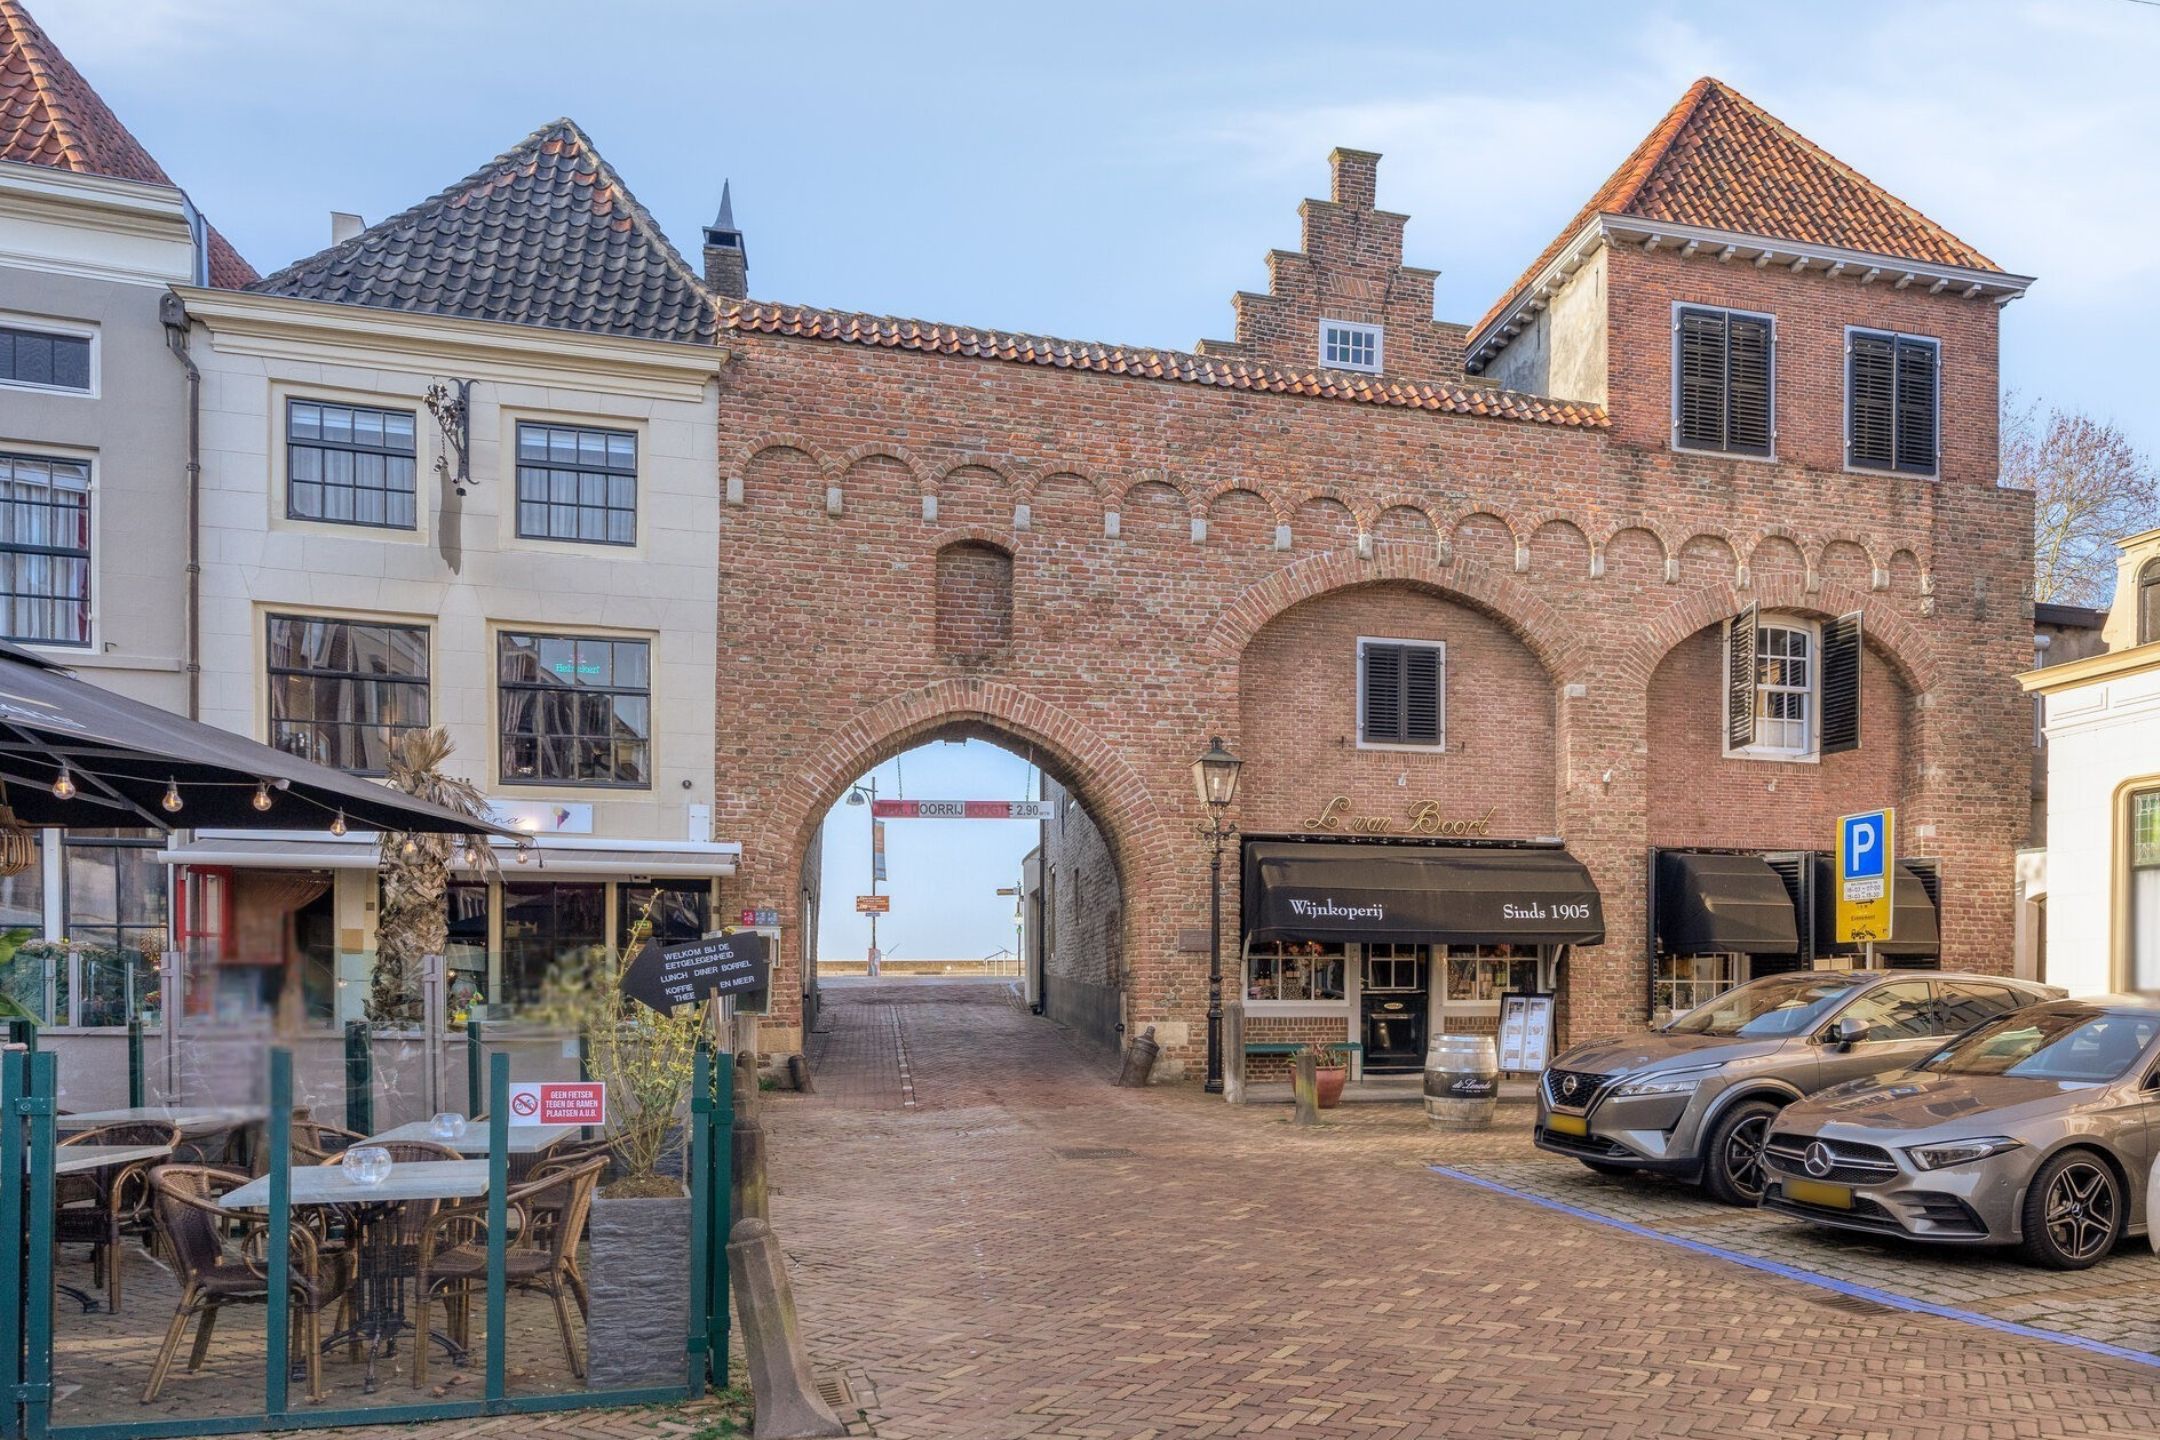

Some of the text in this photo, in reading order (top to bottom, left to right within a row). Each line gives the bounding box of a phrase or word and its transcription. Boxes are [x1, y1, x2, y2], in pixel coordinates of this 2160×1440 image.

[1352, 816, 1393, 833] van
[1392, 799, 1498, 836] Boort
[1852, 822, 1876, 872] P
[1288, 898, 1384, 921] Wijnkoperij
[1503, 902, 1590, 920] Sinds 1905
[664, 943, 730, 961] WELKOM BIJ DE
[665, 951, 734, 970] EETGELEGENHEID
[660, 960, 752, 983] LUNCH DINER BORREL
[665, 975, 755, 995] KOFFIE EN MEER
[674, 991, 696, 1002] THEE
[550, 1090, 593, 1099] GEEN FIETSEN
[545, 1100, 598, 1108] TEGEN DE RAMEN
[546, 1109, 578, 1118] PLAATSEN
